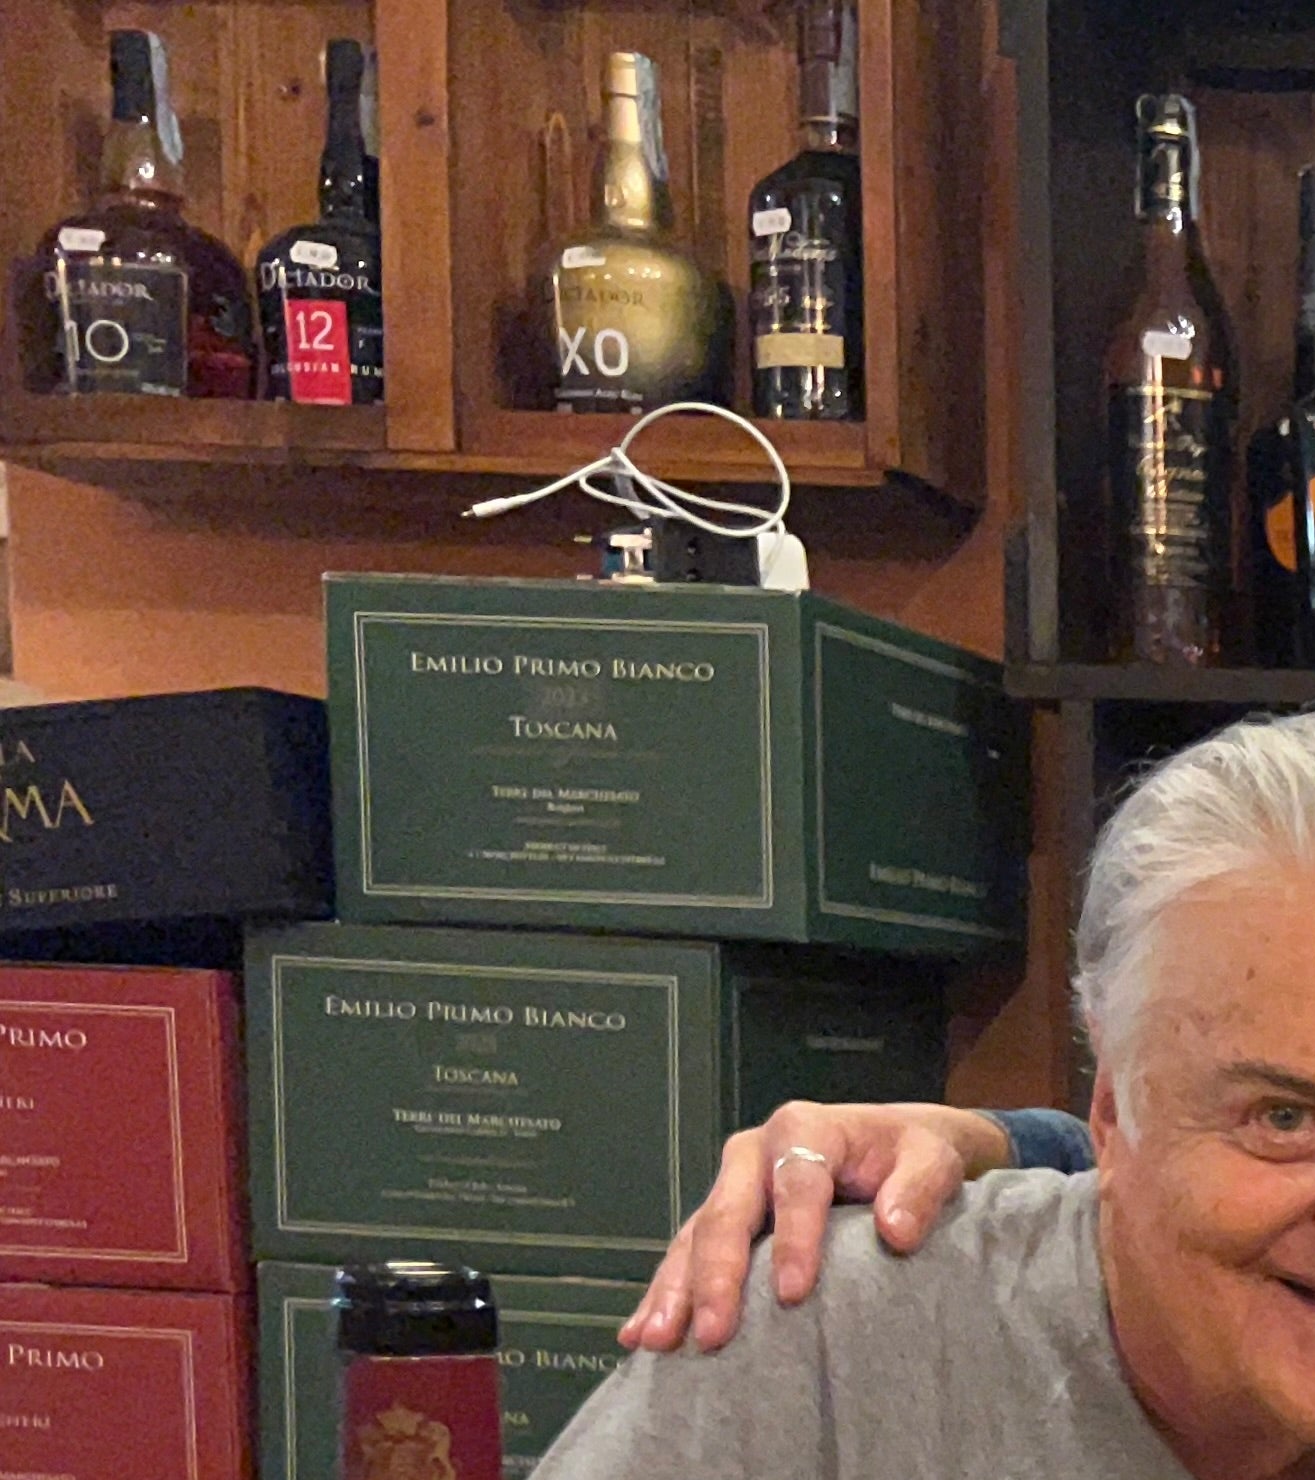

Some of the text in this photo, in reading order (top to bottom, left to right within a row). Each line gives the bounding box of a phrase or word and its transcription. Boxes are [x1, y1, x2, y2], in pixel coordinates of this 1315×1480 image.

[295, 310, 335, 351] 12
[558, 326, 629, 377] XO
[410, 652, 715, 682] EMILIO PRIMO BIANCO
[508, 714, 618, 742] TOSCANA
[325, 994, 627, 1031] EMILIO PRIMO BIANCO
[432, 1064, 519, 1087] TOSCANA
[8, 1343, 104, 1372] PRIMO
[535, 1350, 622, 1371] BIANC
